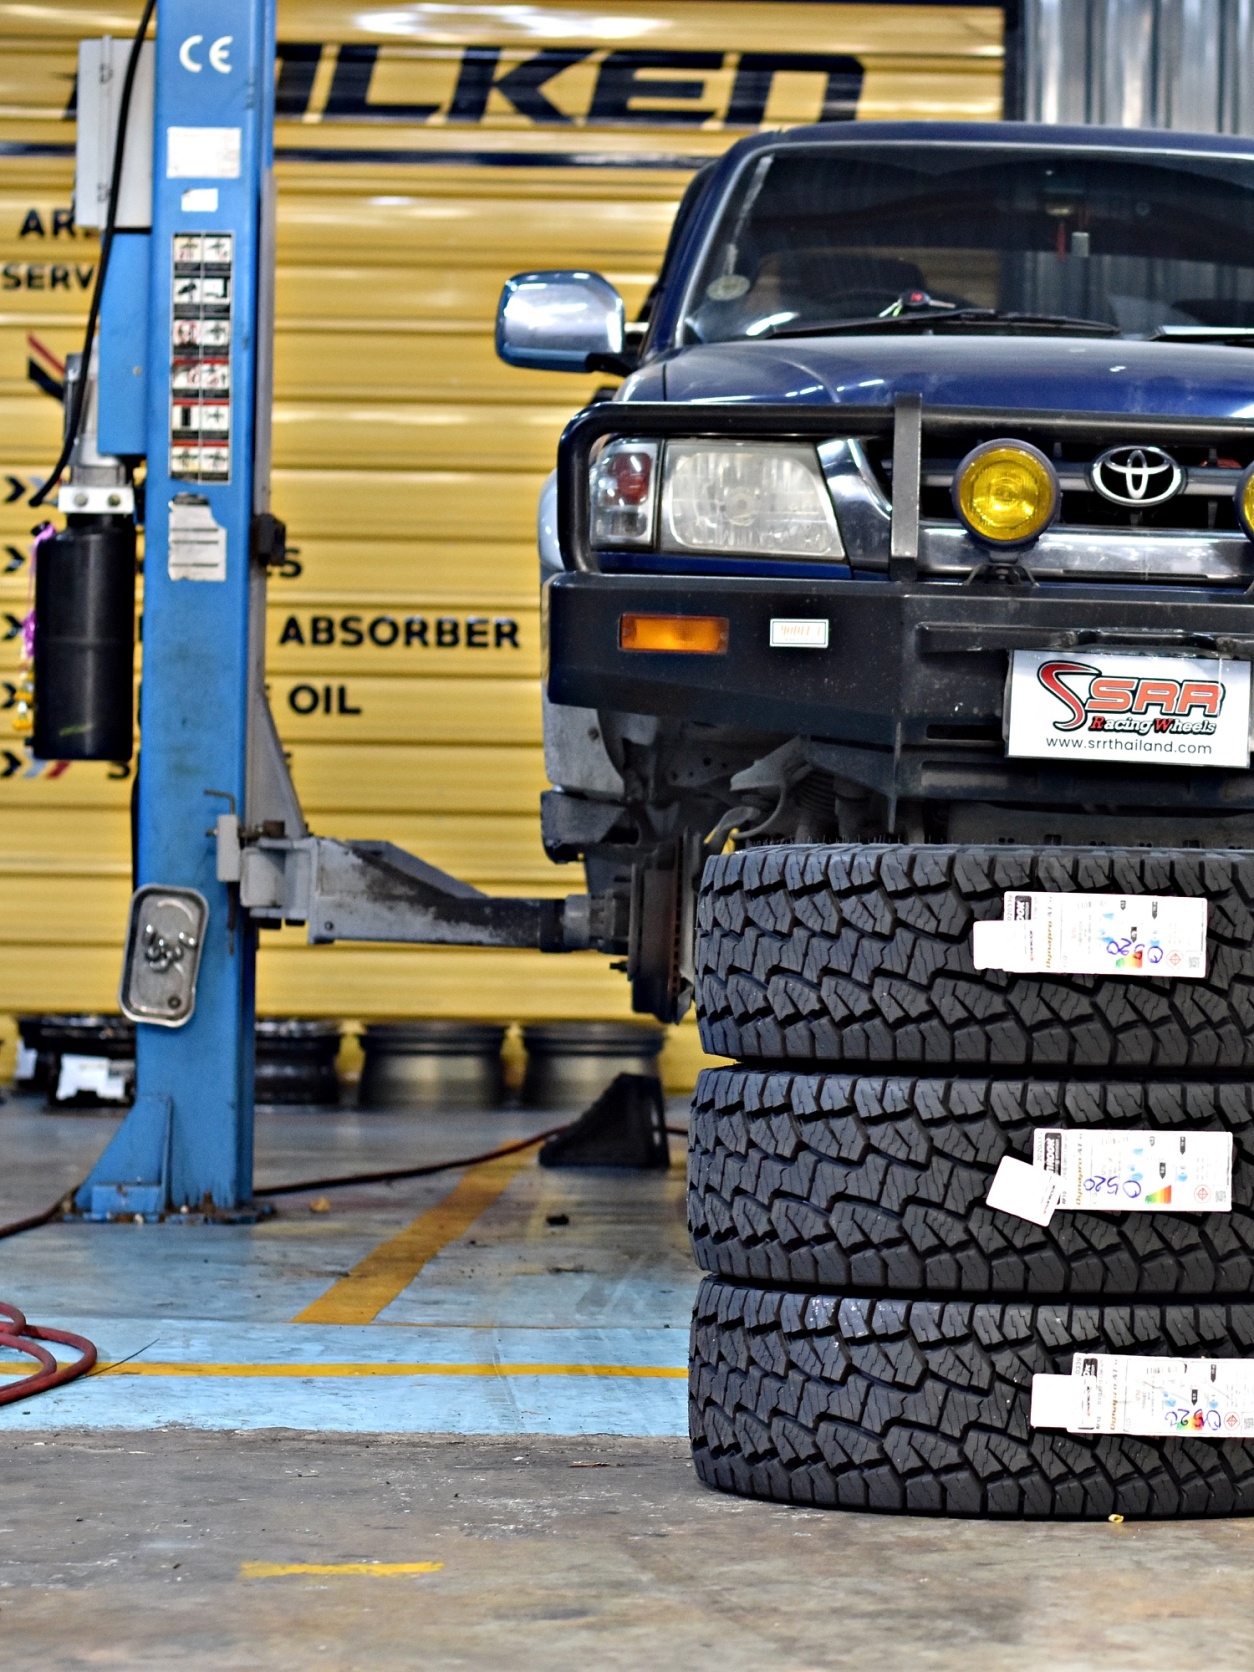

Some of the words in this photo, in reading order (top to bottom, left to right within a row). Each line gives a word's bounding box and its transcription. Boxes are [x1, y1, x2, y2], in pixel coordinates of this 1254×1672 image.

[179, 35, 233, 74] CE
[62, 42, 866, 125] LKEN
[279, 615, 520, 648] ABSORBER
[288, 684, 362, 716] OIL
[1089, 715, 1154, 736] Racing
[1153, 717, 1217, 735] Wheels
[1046, 737, 1213, 755] www.srrthailand.com
